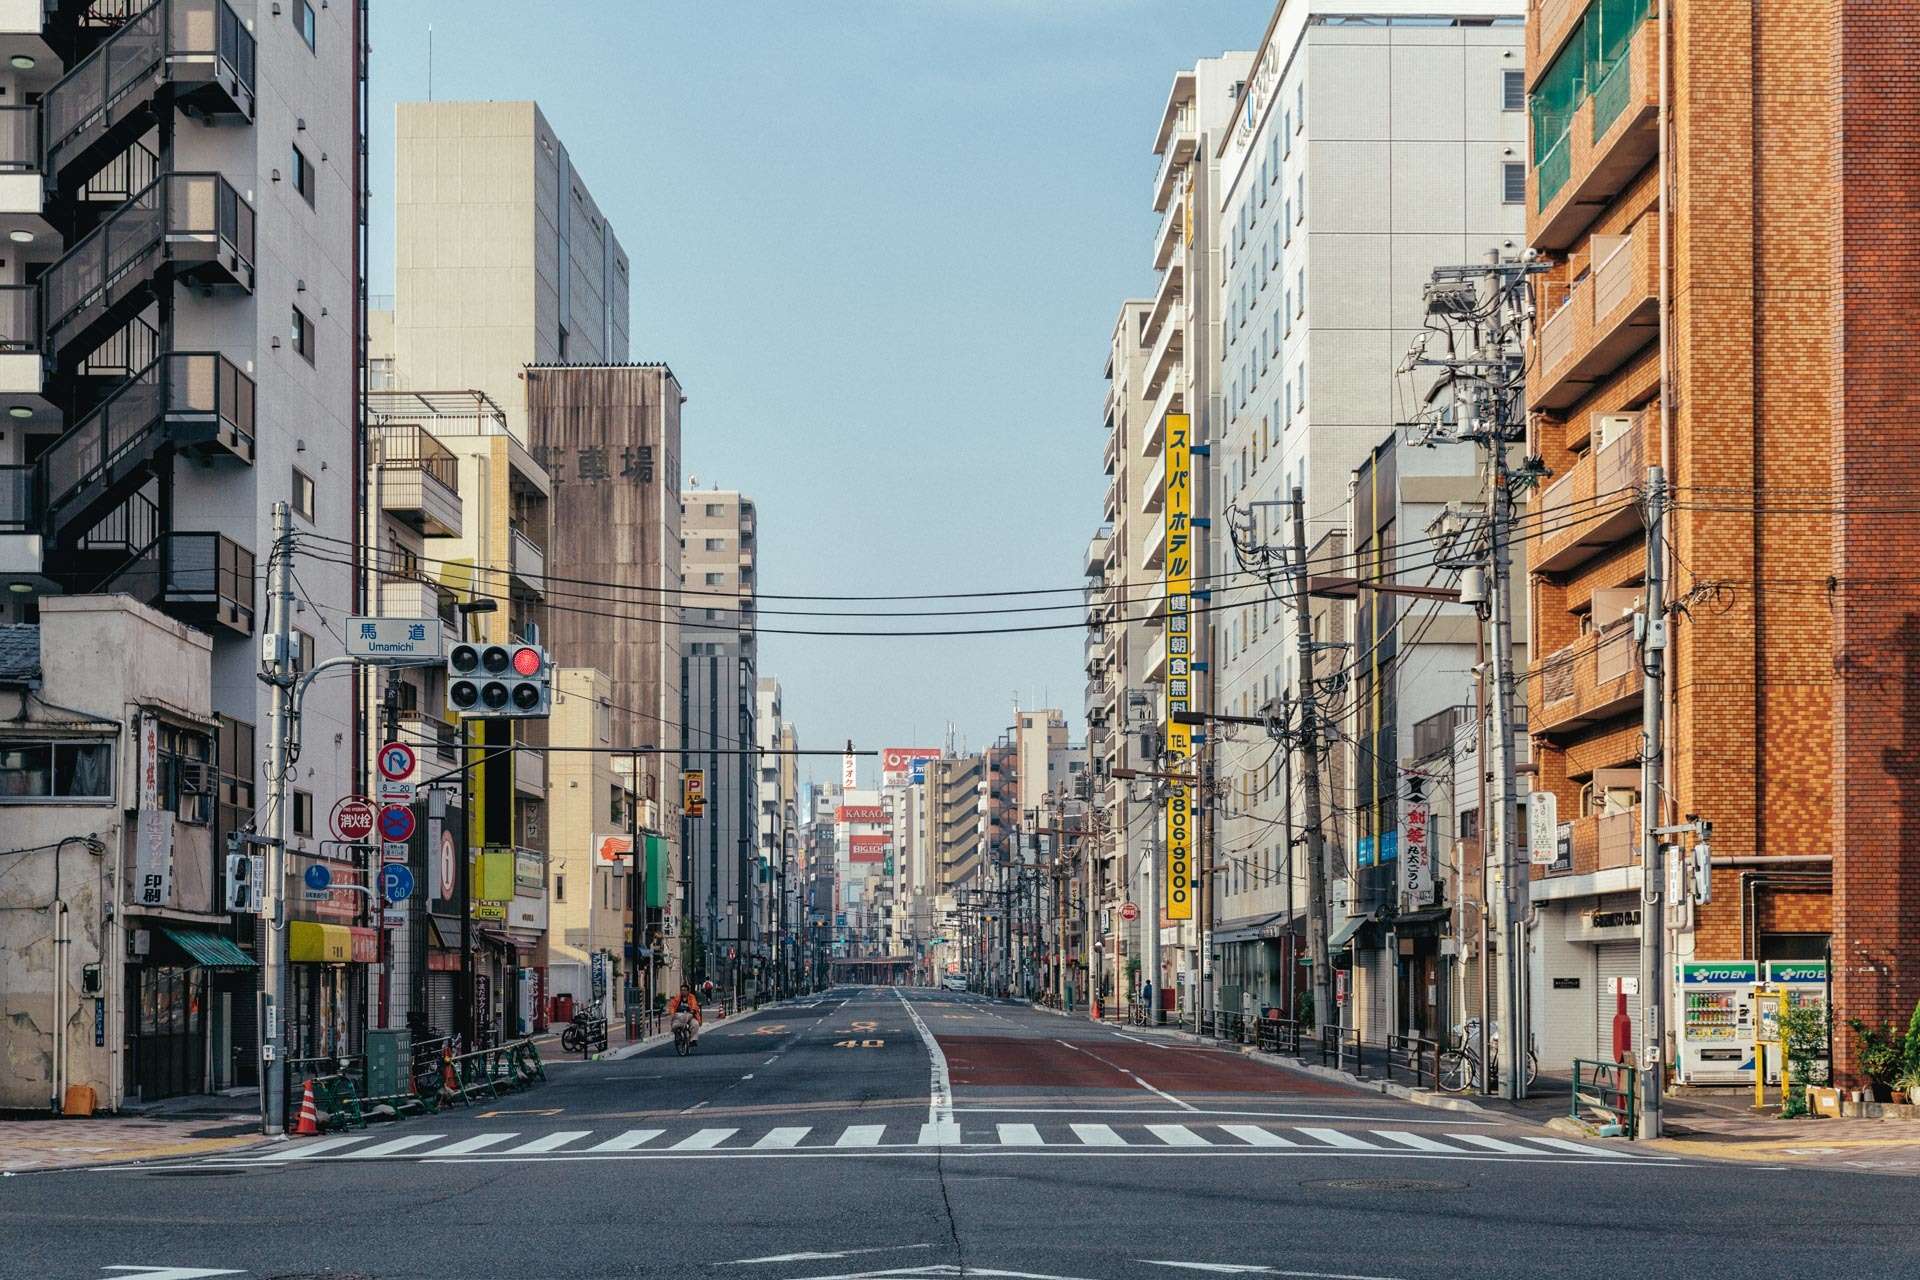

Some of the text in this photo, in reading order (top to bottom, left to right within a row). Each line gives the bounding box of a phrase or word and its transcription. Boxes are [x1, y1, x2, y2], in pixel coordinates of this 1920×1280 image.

[1169, 430, 1188, 577] スーパーホテル
[360, 624, 425, 640] 馬道
[368, 642, 414, 652] Umamichi
[1171, 735, 1187, 748] TEL
[400, 784, 410, 792] 20
[689, 781, 700, 791] P
[341, 813, 371, 828] 消火栓
[386, 874, 399, 897] P
[395, 888, 405, 898] 60
[1709, 970, 1747, 980] ITO EN
[1796, 970, 1825, 980] ITO E
[832, 1039, 885, 1049] 40
